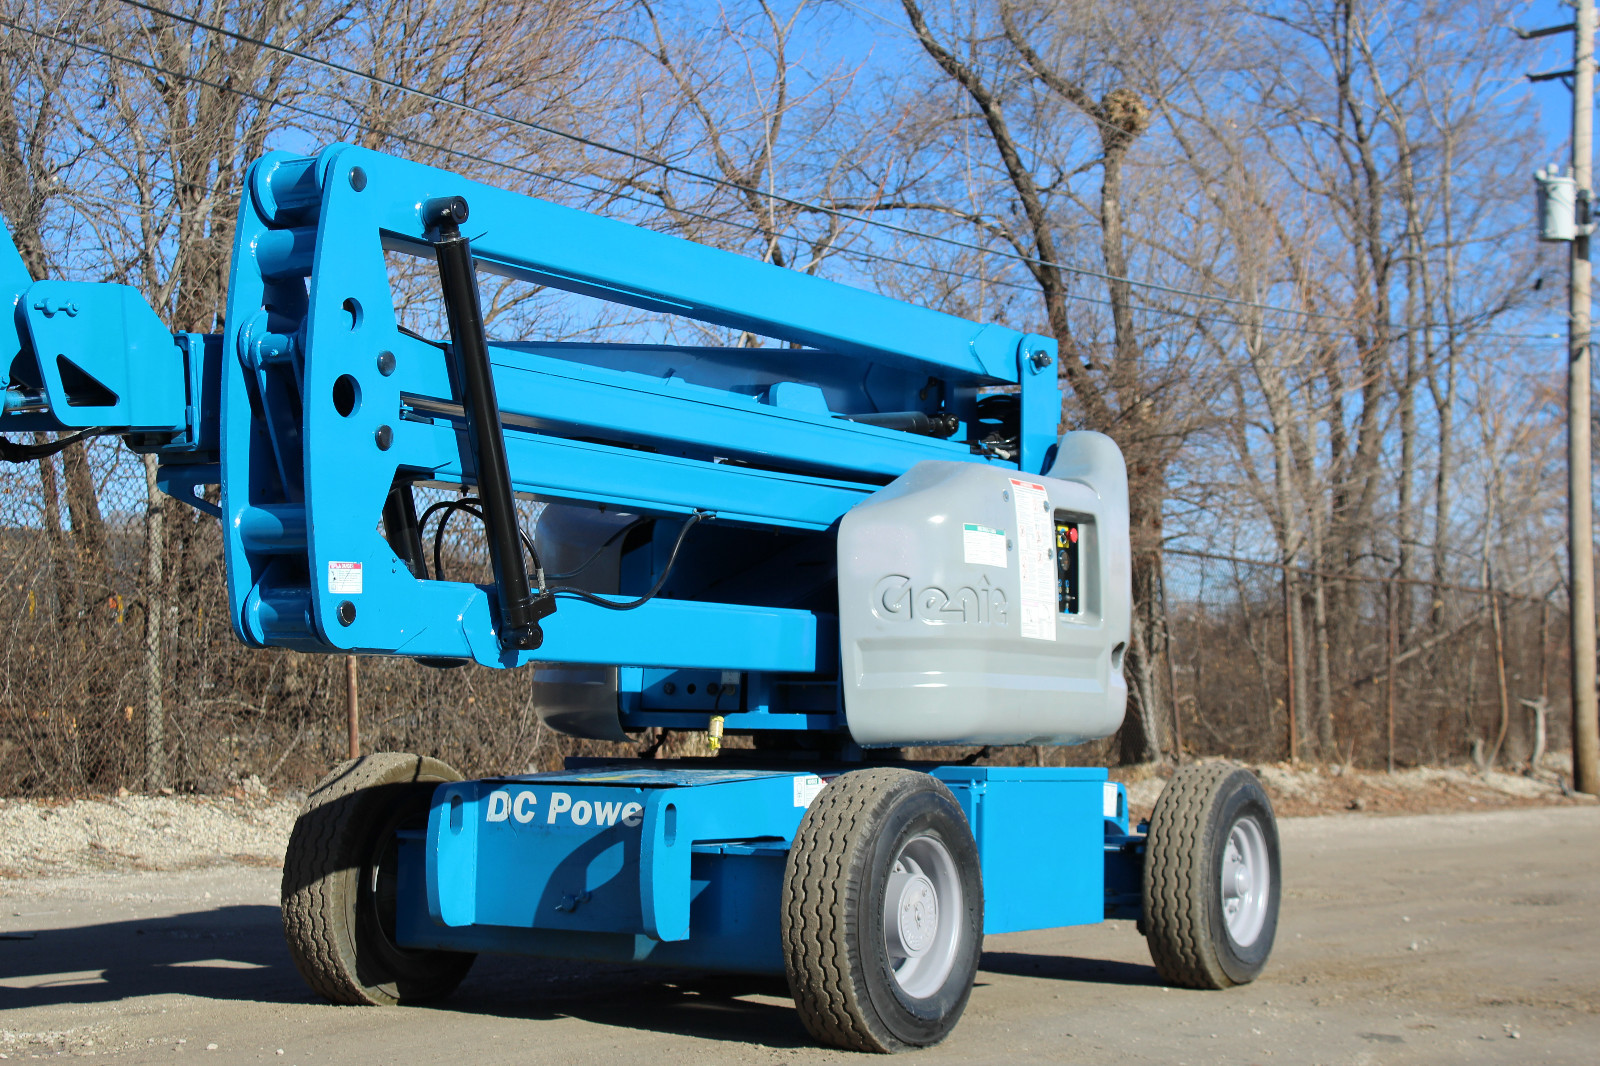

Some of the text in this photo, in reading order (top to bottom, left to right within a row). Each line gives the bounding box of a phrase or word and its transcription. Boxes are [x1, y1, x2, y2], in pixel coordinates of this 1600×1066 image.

[870, 574, 1007, 626] Genie
[486, 790, 644, 827] DC Powe
